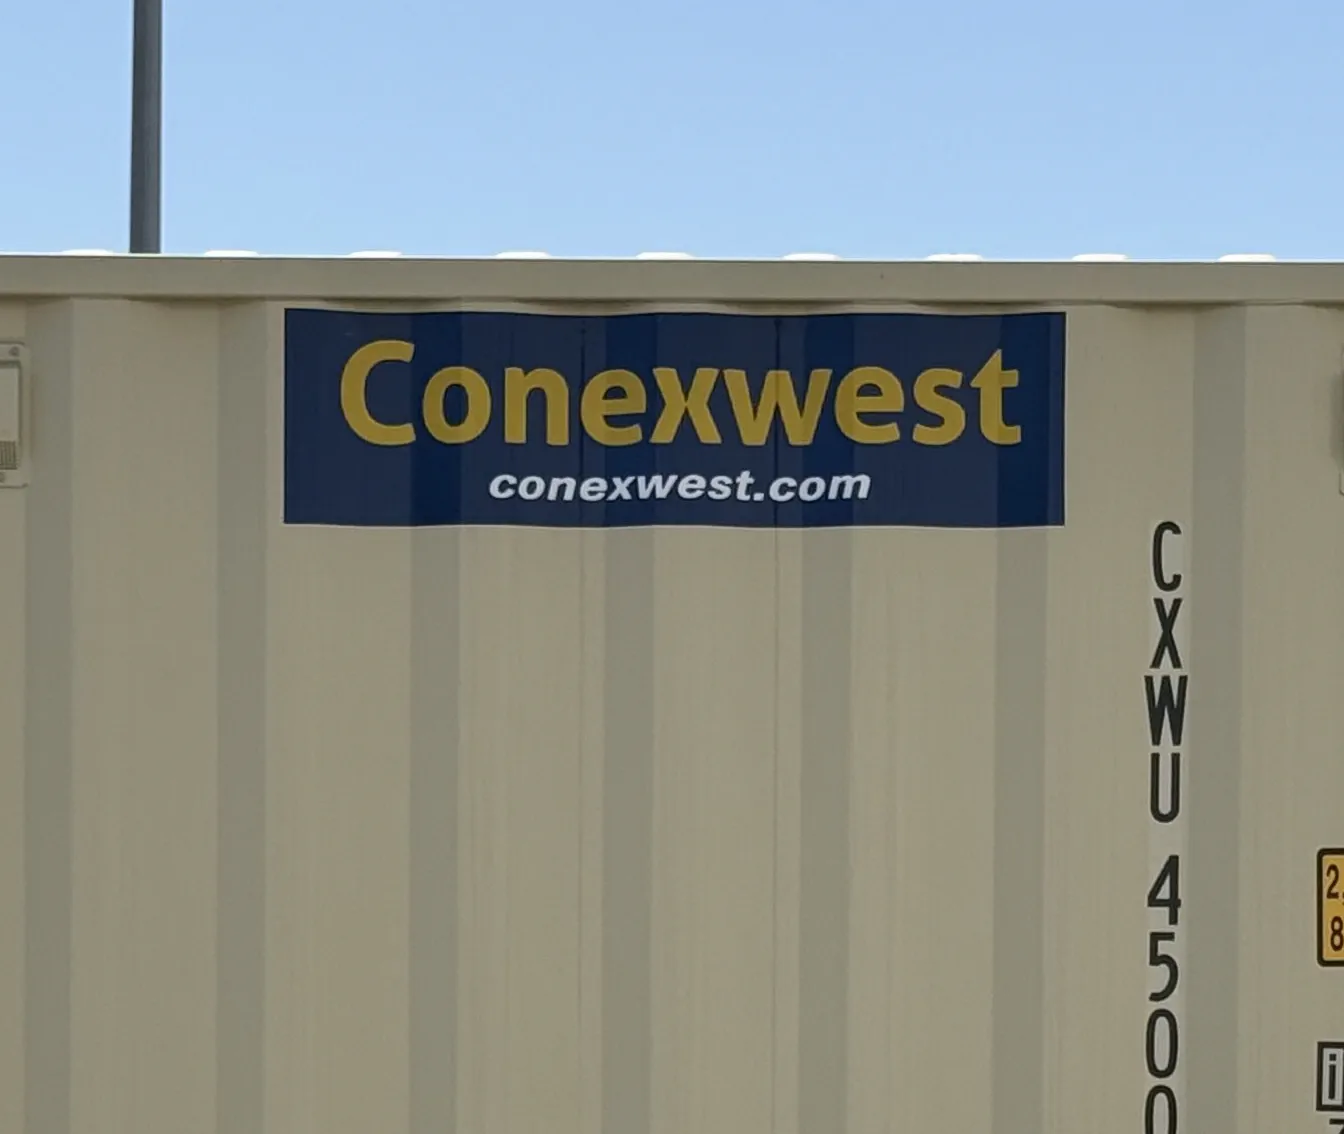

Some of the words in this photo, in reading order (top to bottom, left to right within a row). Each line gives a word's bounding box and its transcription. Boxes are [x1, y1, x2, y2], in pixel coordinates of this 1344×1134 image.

[340, 339, 1022, 447] Conexwest
[488, 469, 872, 502] conexwest.com
[1143, 520, 1189, 824] CXWU
